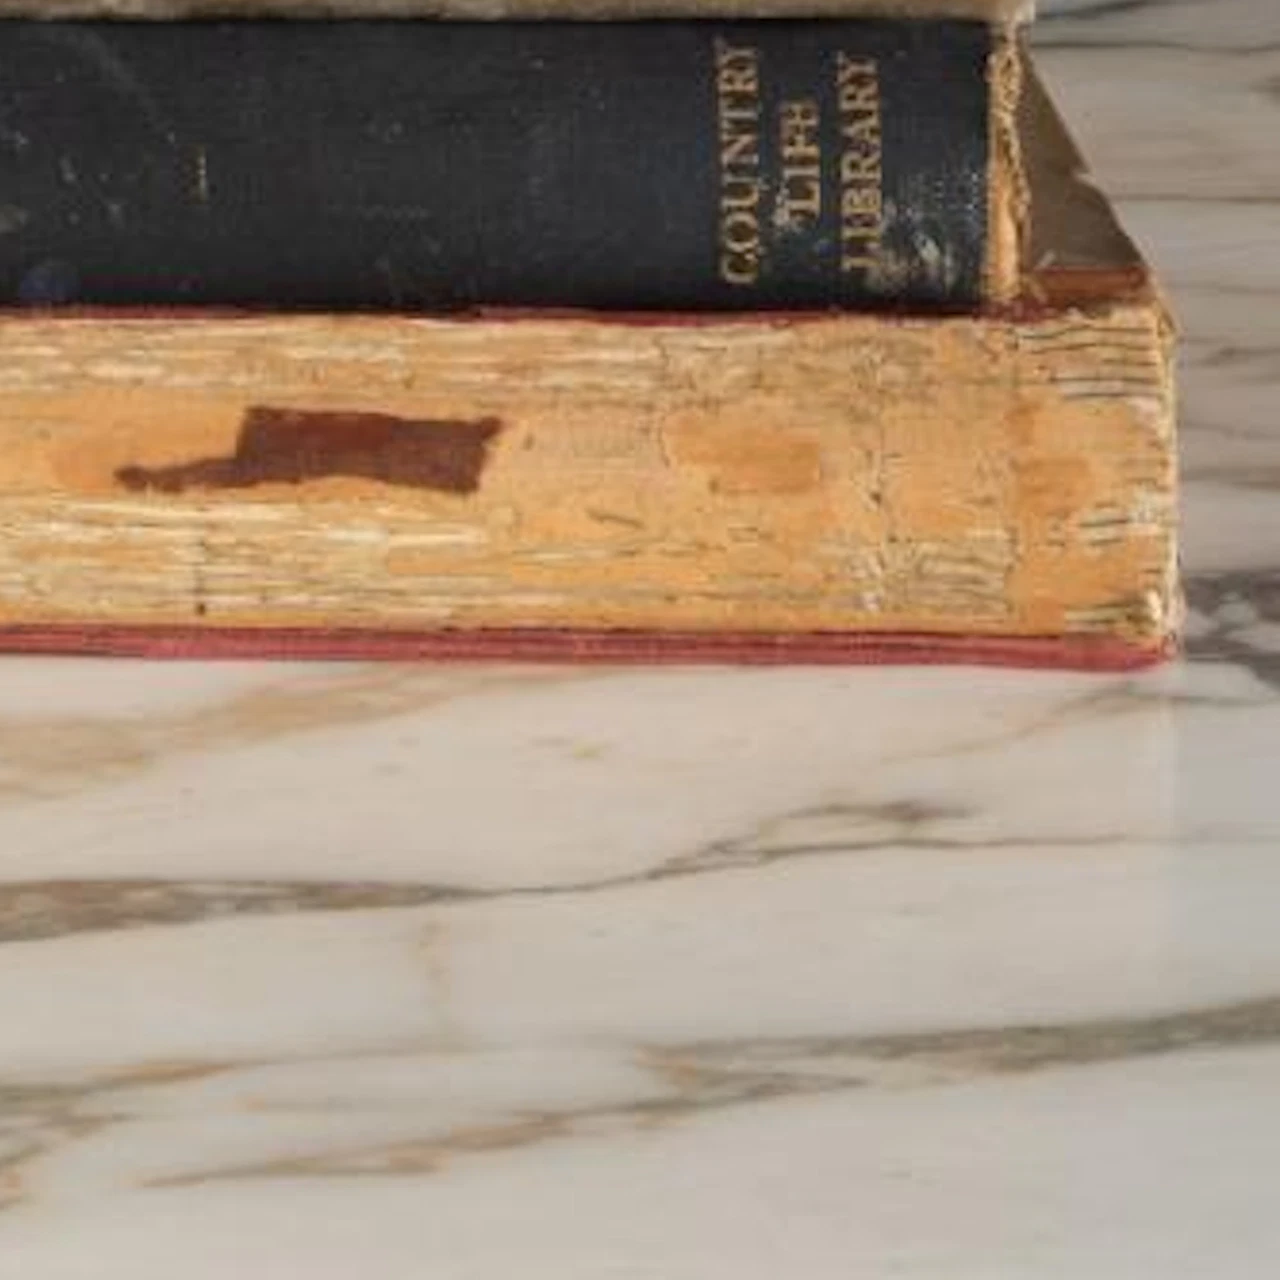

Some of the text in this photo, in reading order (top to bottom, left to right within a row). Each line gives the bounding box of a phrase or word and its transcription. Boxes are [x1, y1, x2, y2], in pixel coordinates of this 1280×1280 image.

[713, 37, 762, 285] COUNTRY
[778, 99, 822, 225] LIFE
[837, 51, 884, 273] LIBRARY
